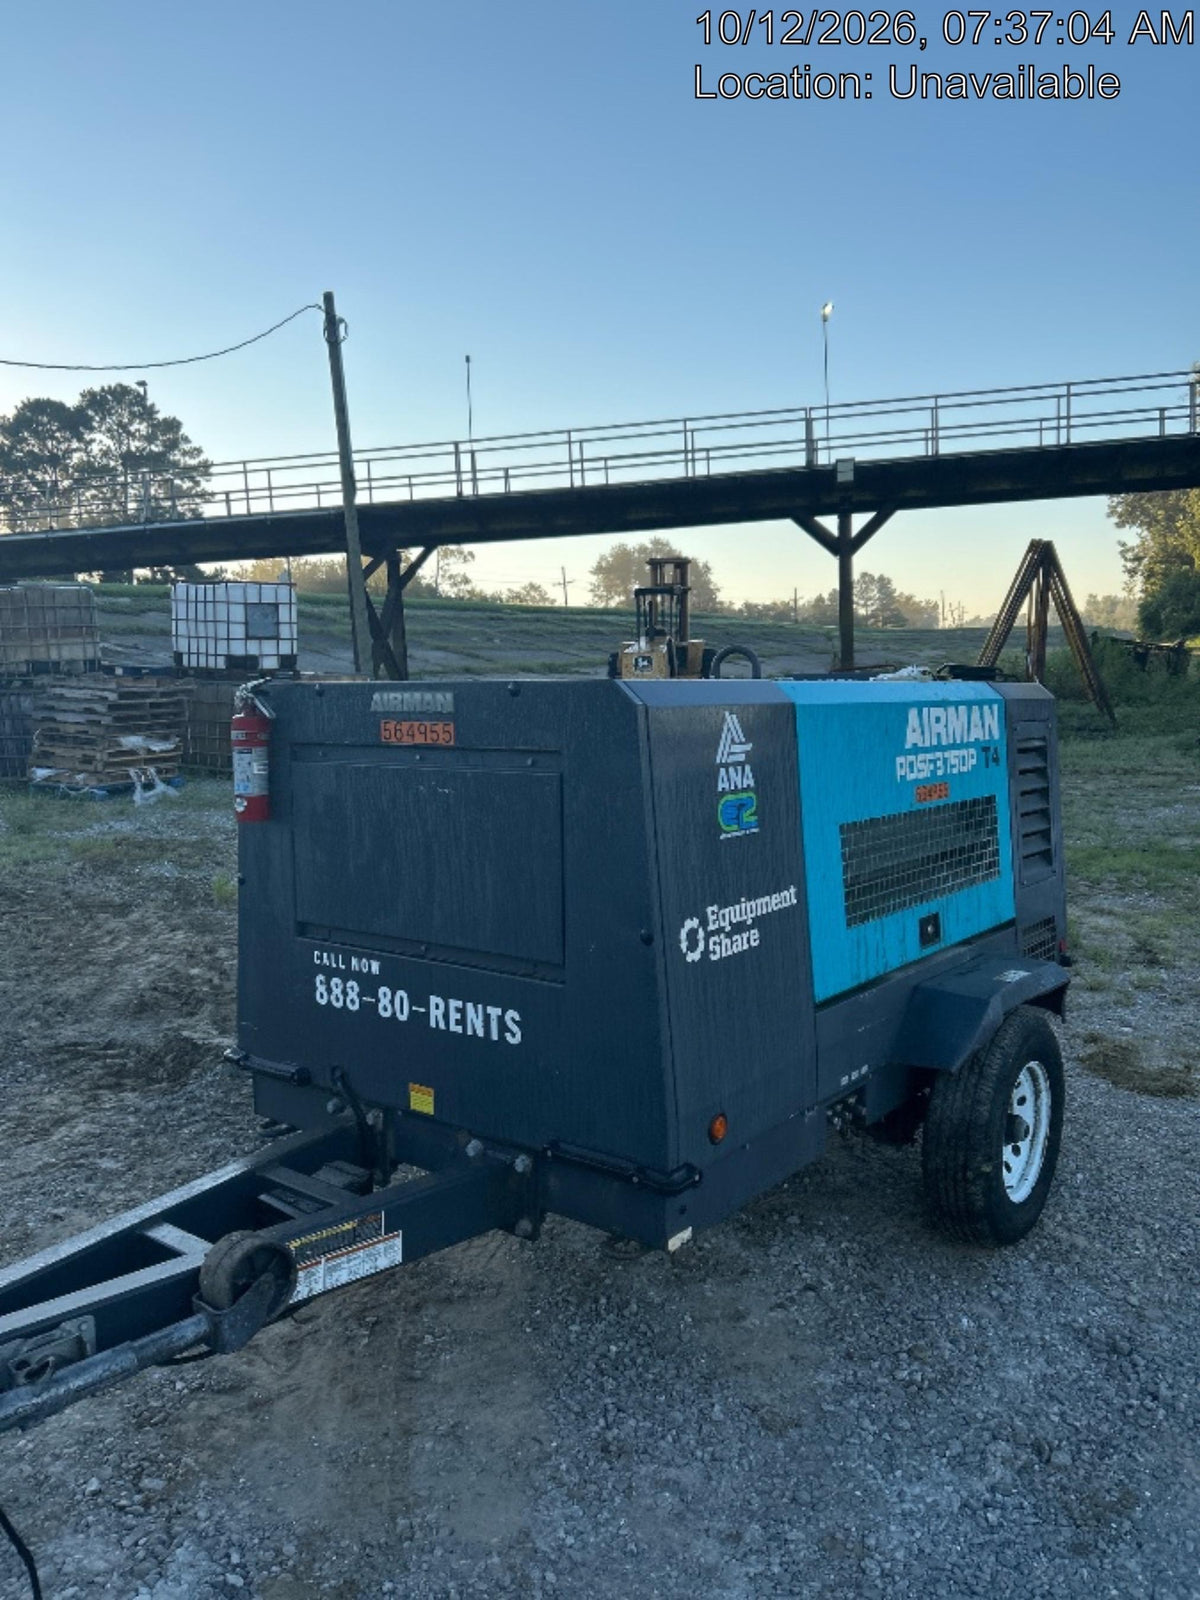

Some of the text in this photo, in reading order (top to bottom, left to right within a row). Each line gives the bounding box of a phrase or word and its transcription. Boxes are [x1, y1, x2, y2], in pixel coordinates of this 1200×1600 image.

[370, 691, 455, 713] AIRMAN
[382, 721, 453, 744] 564955
[905, 704, 1000, 749] AIRMAN
[717, 764, 755, 792] ANA
[706, 885, 798, 932] Equipment
[708, 928, 760, 962] Share
[313, 950, 382, 976] CALL NOW
[315, 973, 522, 1045] 888-80-RENTS
